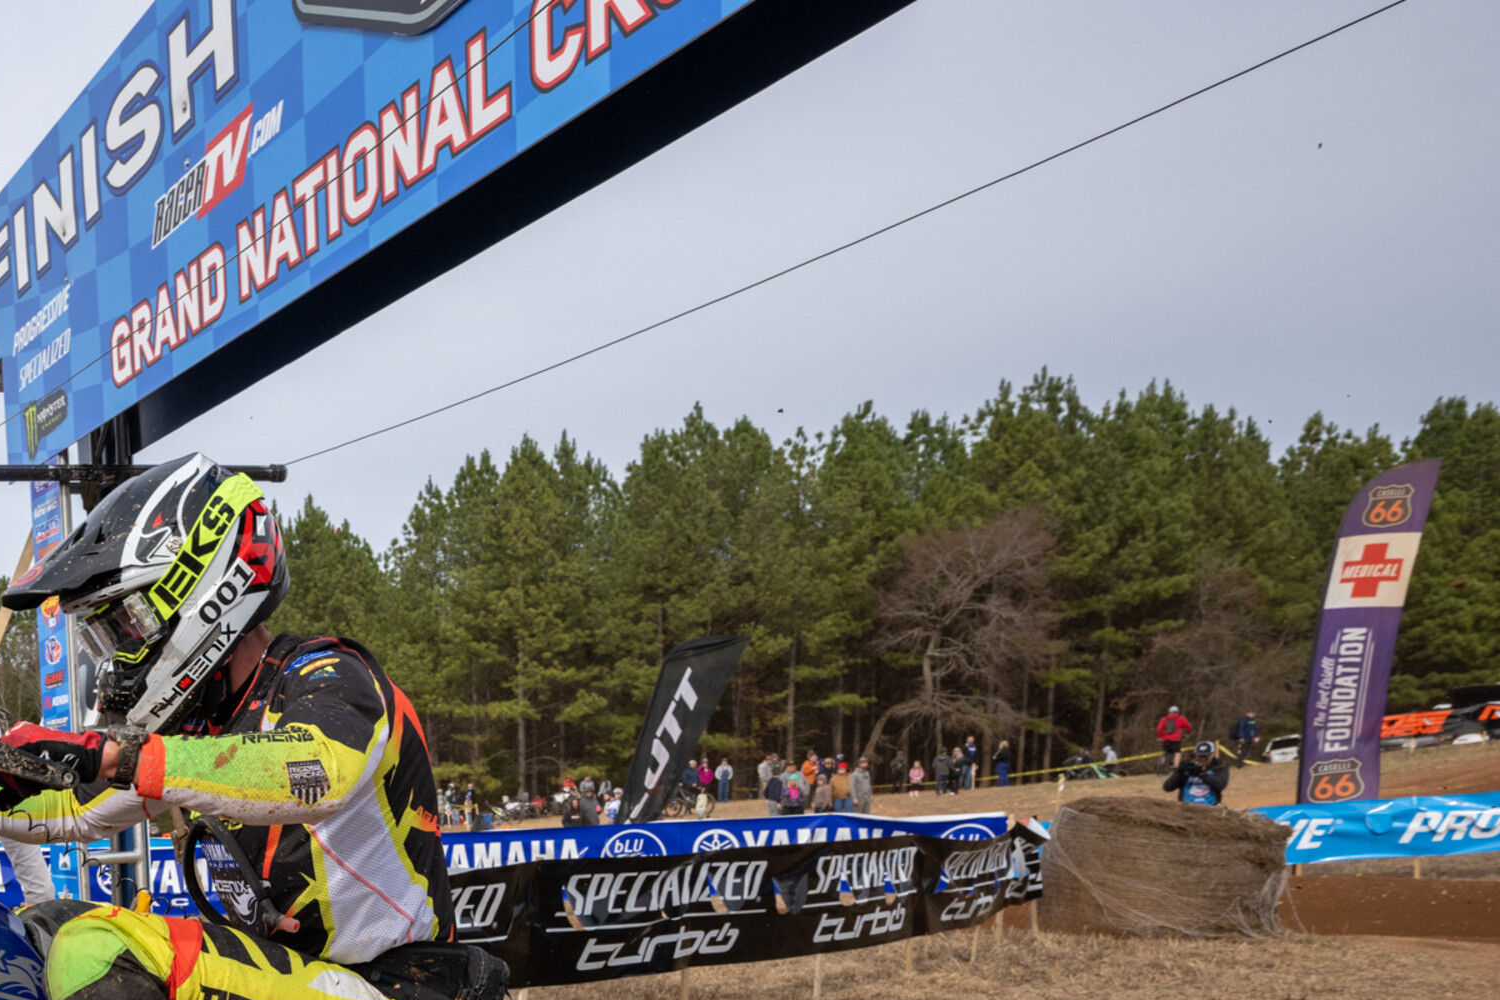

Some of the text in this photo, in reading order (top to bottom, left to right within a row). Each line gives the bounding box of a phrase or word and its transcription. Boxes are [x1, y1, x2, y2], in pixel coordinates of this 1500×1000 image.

[110, 241, 226, 388] GRAND
[237, 27, 512, 304] NATIONAL
[13, 283, 71, 358] PROGRESSIVE
[18, 328, 72, 392] SPECIALIZED
[37, 395, 66, 423] MONSTER
[1369, 499, 1403, 524] 66
[1342, 563, 1399, 578] MEDICAL
[199, 563, 255, 625] 001
[150, 621, 238, 718] PHOENIX
[1324, 627, 1368, 752] FOUNDATION
[242, 732, 314, 745] RACING
[1313, 711, 1327, 728] The
[1314, 773, 1356, 799] 66
[1318, 762, 1351, 773] CASELLI
[566, 860, 768, 917] SPECIALIZED
[807, 846, 918, 895] SPECIALIZED
[813, 903, 906, 943] turbo
[940, 893, 994, 921] turb
[576, 922, 739, 971] turbo
